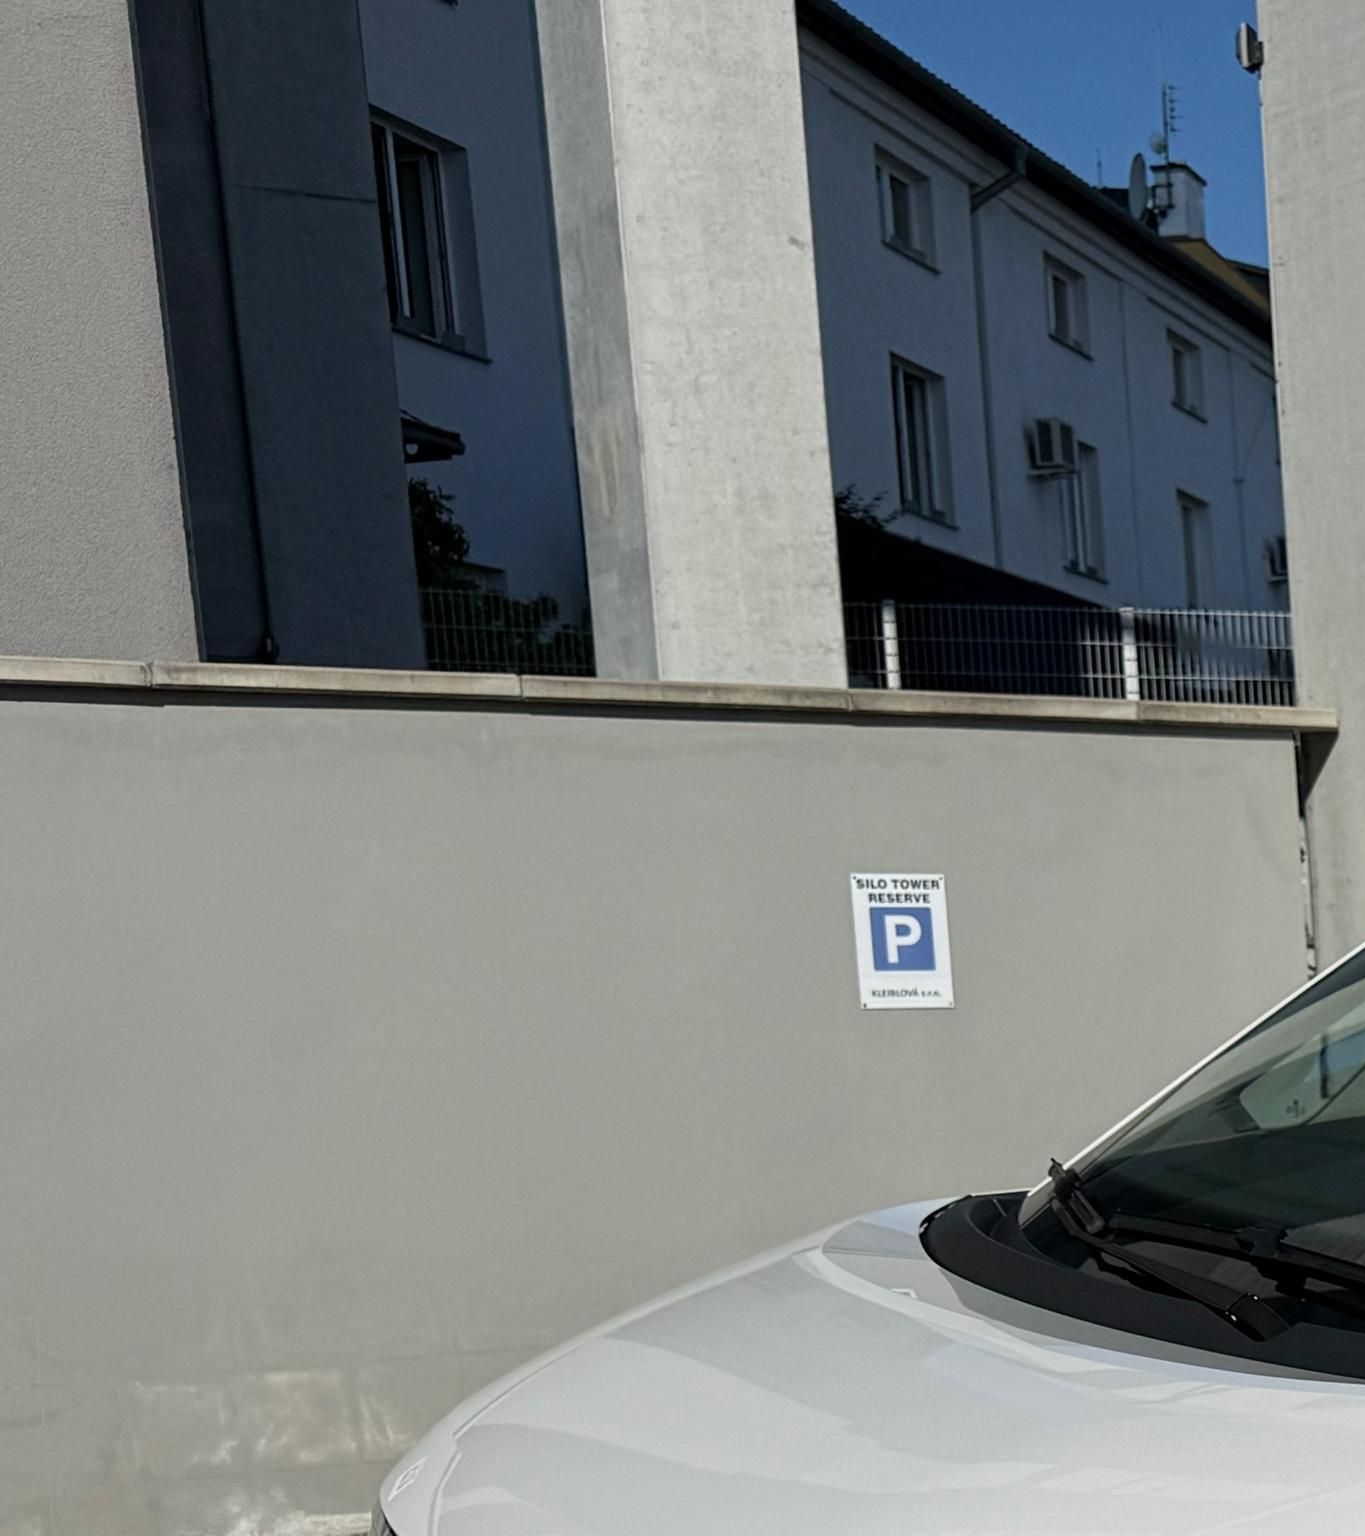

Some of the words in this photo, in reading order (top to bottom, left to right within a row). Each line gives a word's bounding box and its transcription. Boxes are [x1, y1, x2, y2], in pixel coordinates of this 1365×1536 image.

[856, 879, 887, 890] SILO
[891, 879, 940, 890] TOWER
[868, 893, 931, 904] RESERVE
[884, 915, 922, 964] P
